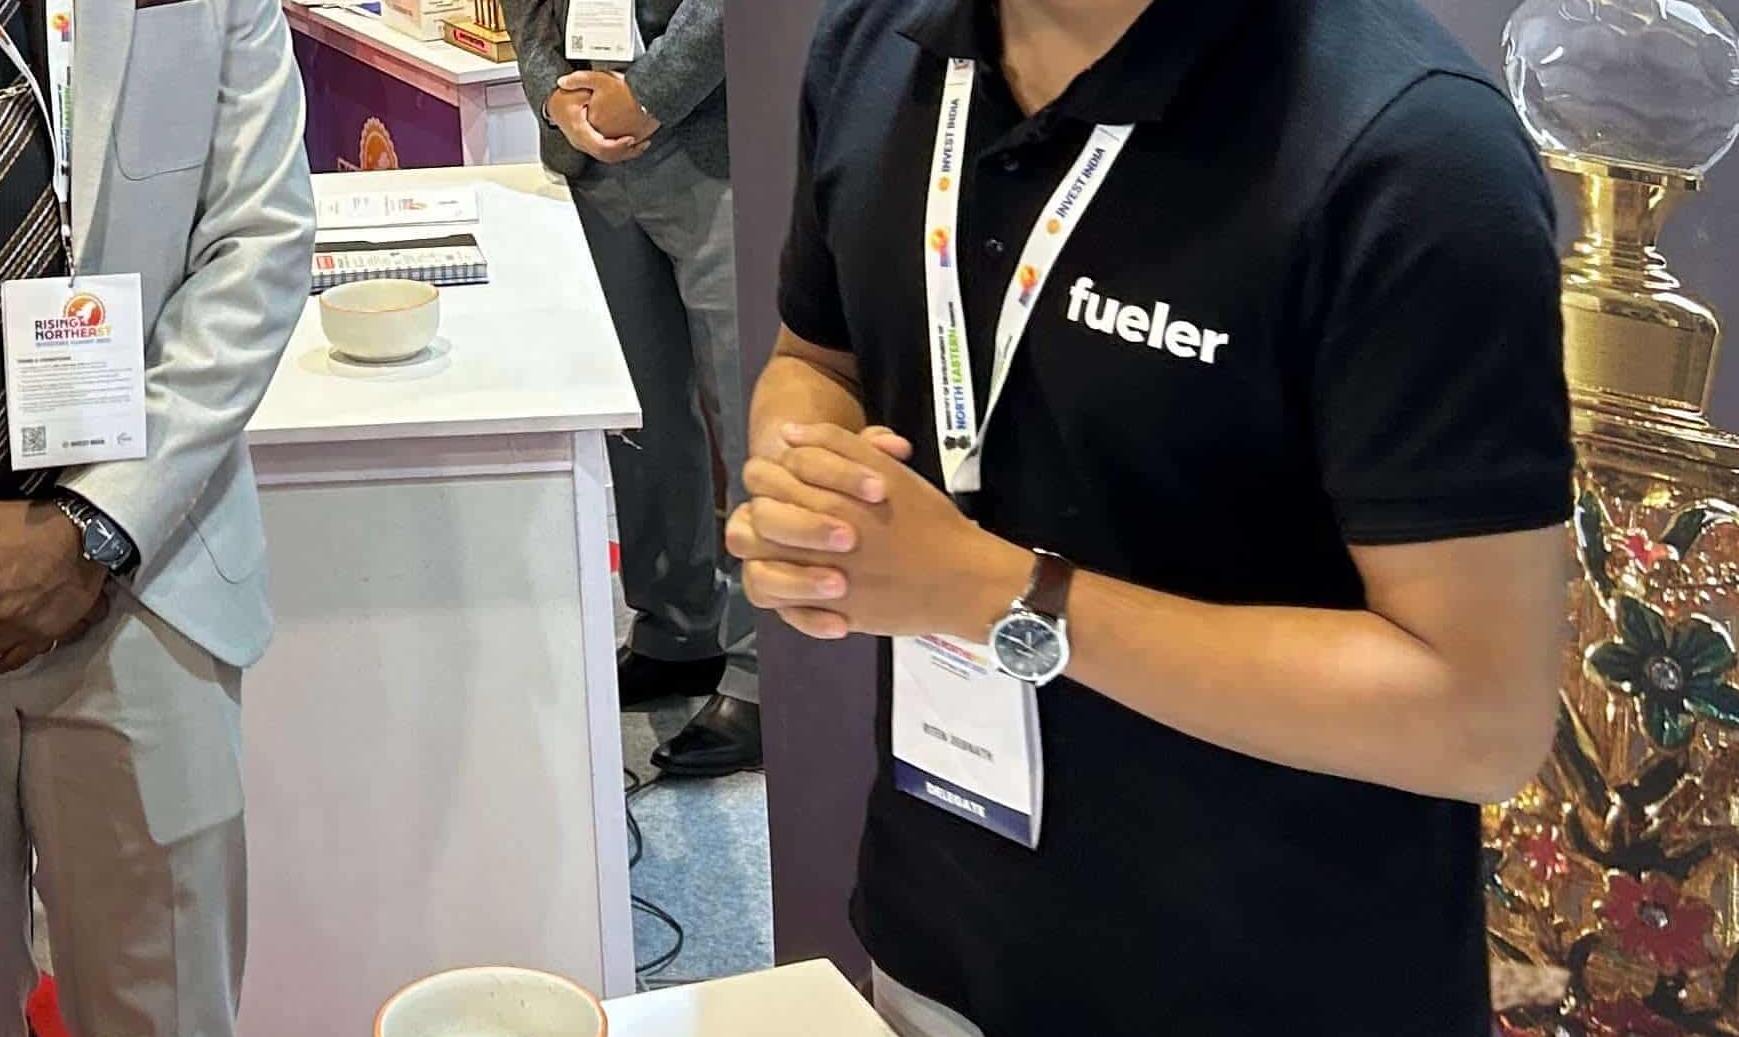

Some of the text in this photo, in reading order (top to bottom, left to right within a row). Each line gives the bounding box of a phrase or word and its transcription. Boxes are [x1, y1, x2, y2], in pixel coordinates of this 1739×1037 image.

[941, 98, 961, 172] INVEST INDIA
[1055, 146, 1106, 218] INVEST INDIA
[35, 317, 79, 330] RISING
[35, 326, 112, 341] NORTHEAST
[1066, 276, 1230, 364] fueler
[948, 328, 963, 384] EASTERN
[953, 385, 967, 430] NORTH
[925, 781, 987, 818] DELEGATE
